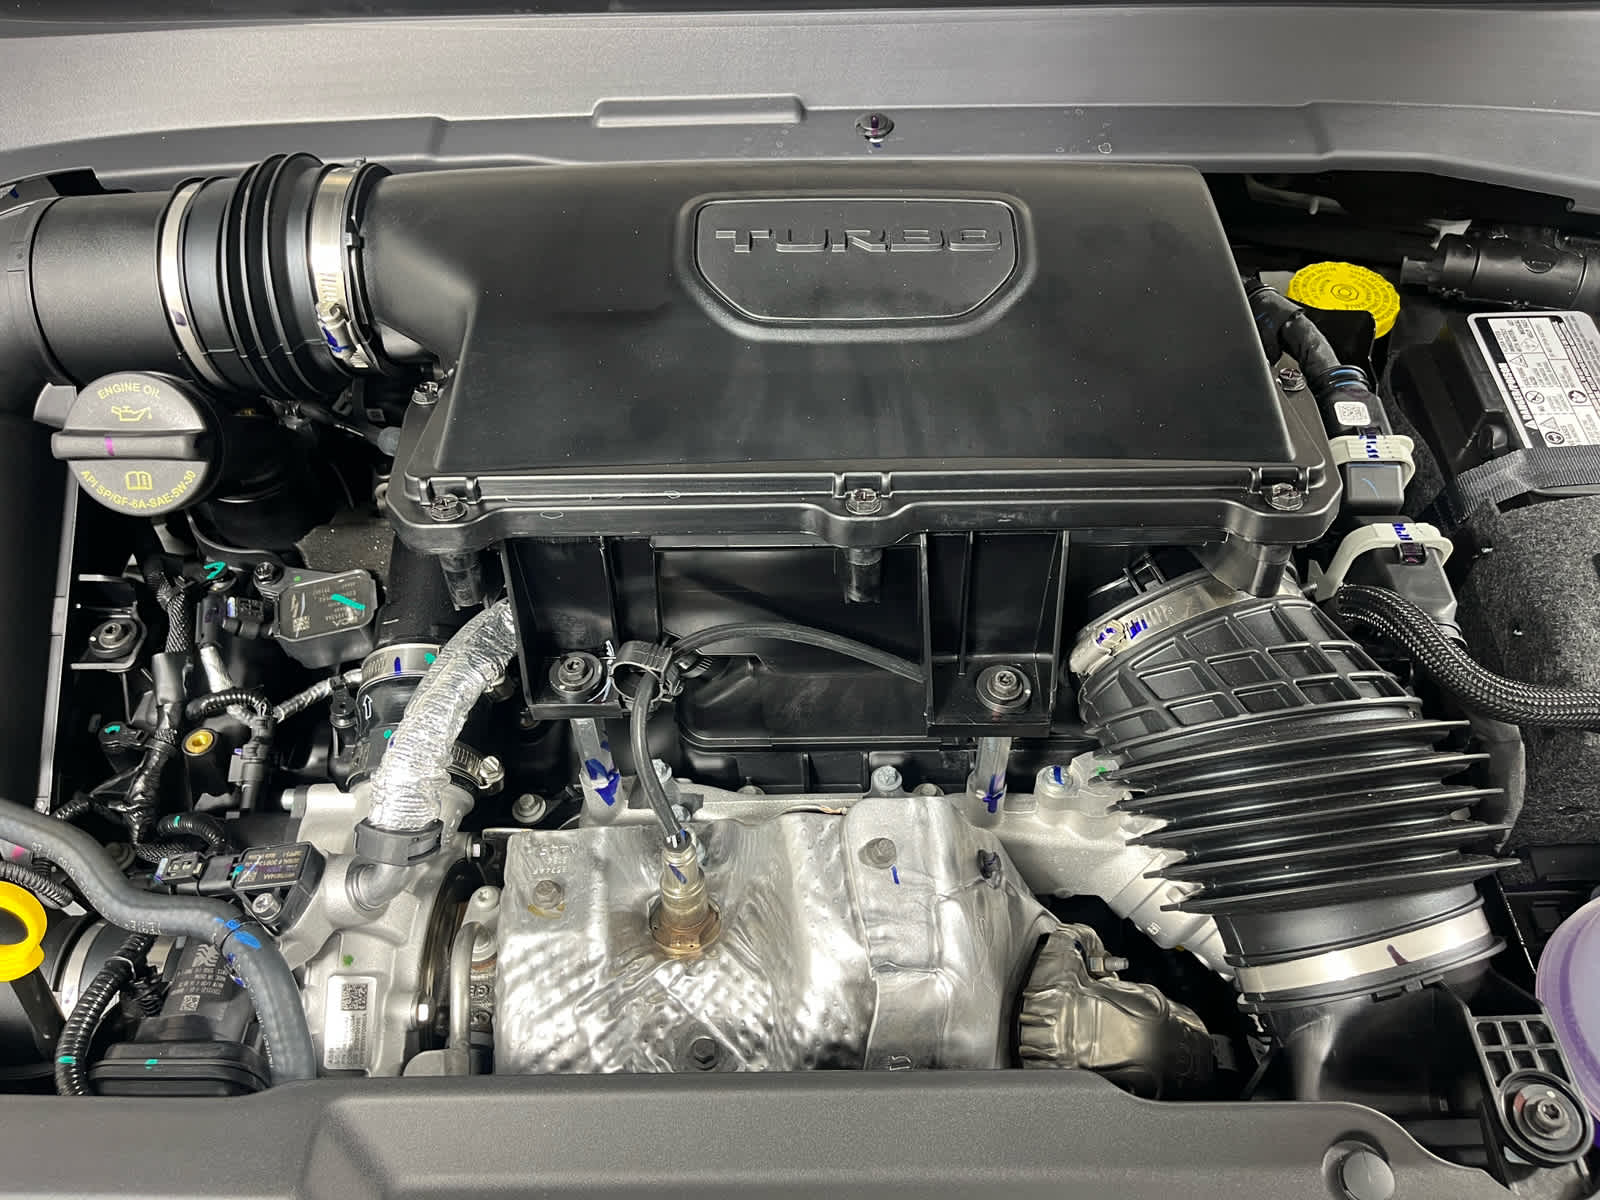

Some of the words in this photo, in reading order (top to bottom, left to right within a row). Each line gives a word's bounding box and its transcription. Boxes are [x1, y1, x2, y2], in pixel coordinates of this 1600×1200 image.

[715, 229, 1001, 253] TURBO
[97, 382, 140, 400] ENGINE
[143, 384, 161, 400] OIL
